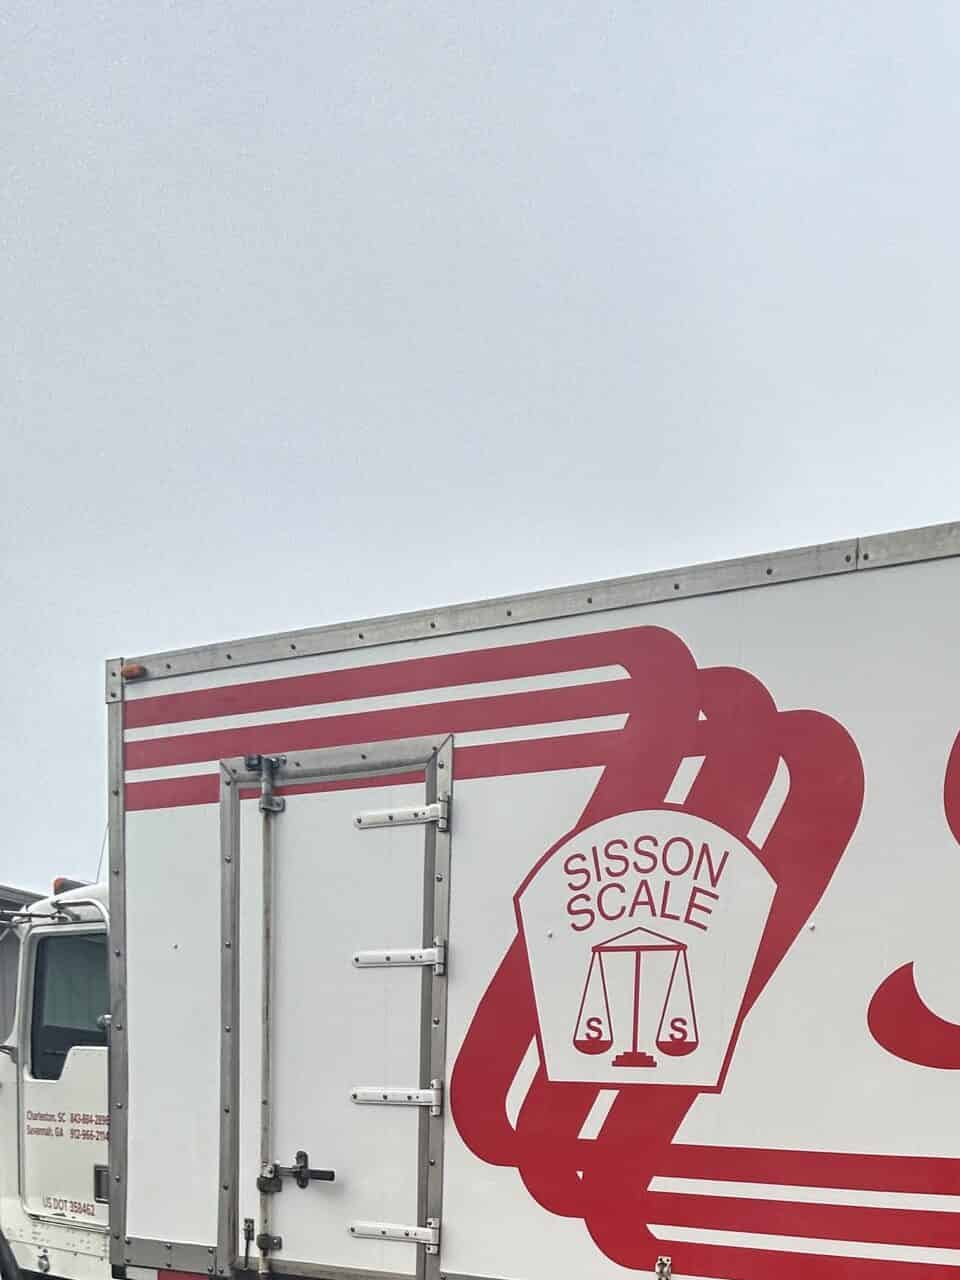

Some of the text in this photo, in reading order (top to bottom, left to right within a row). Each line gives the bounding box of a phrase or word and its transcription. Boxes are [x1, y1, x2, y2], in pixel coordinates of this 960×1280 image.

[563, 835, 729, 891] SISSON
[566, 879, 720, 932] SCALE
[585, 1017, 604, 1040] S
[669, 1018, 688, 1041] S
[57, 1112, 66, 1123] SC
[43, 1196, 52, 1208] US
[53, 1198, 68, 1211] DOT
